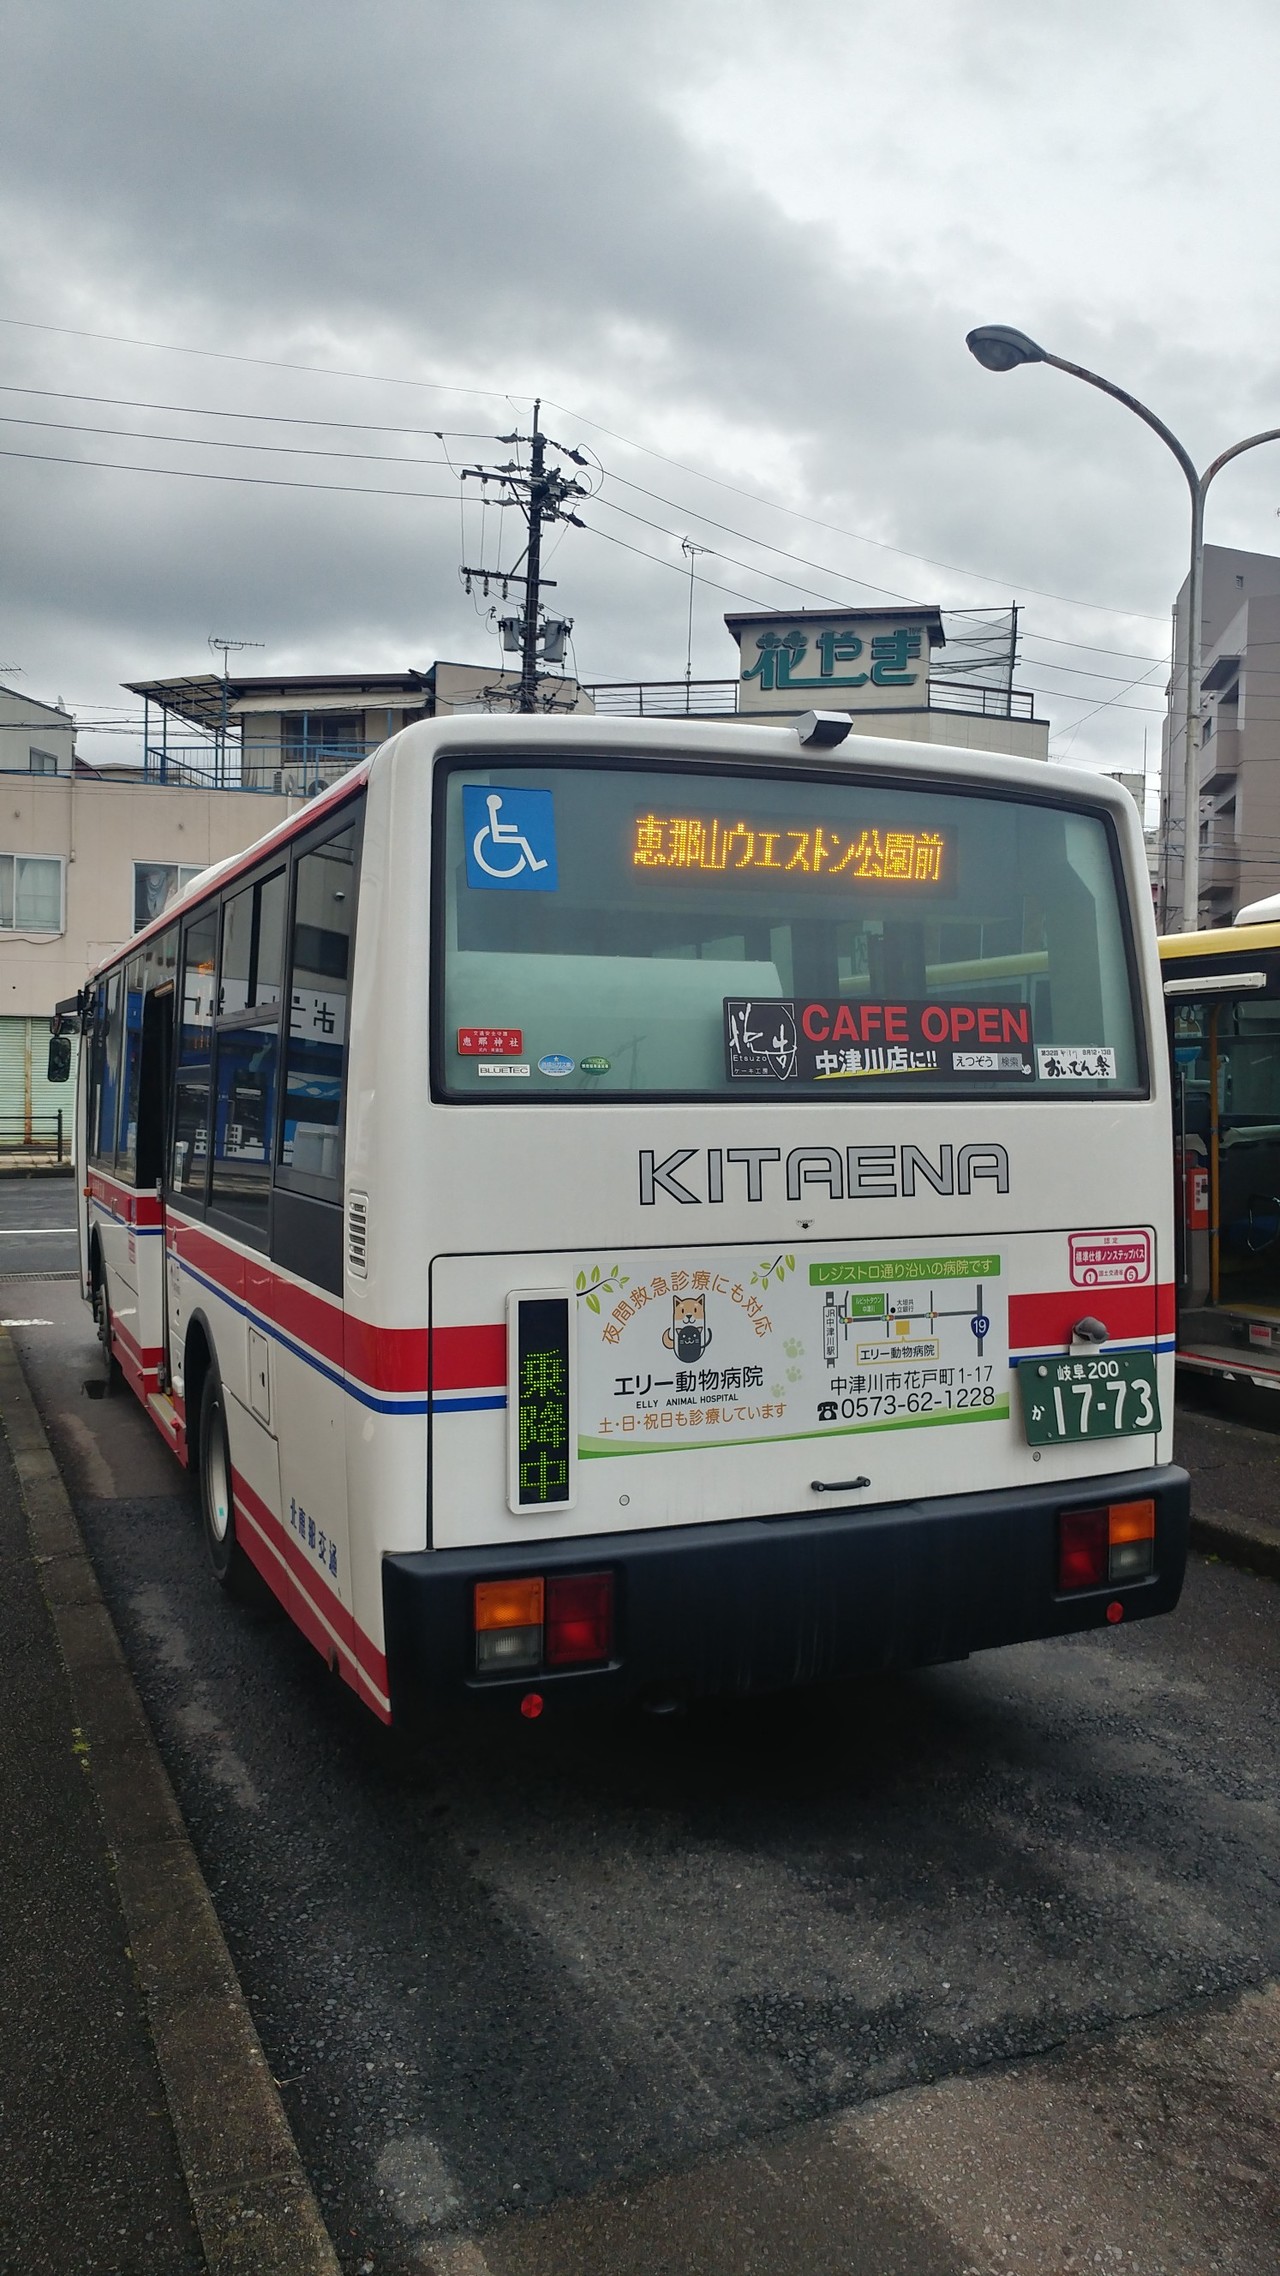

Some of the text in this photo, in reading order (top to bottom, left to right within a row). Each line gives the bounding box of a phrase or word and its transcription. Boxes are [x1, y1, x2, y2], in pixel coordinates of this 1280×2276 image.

[633, 815, 944, 880] 恵那山ウエストン公園前
[802, 1004, 1029, 1043] CAFE OPEN
[733, 1054, 767, 1062] Etsuzo
[815, 1046, 937, 1075] 中津川店に!!
[955, 1056, 1021, 1068] えつぞう 検索
[1044, 1055, 1111, 1077] おいでん祭
[479, 1065, 529, 1074] BLUETEC
[734, 1067, 768, 1075] ケーキ工房
[638, 1143, 1010, 1206] KITAENA
[1075, 1248, 1145, 1263] 標準仕様ノンステップバス
[818, 1260, 993, 1281] レジストロ通り沿いの病院です
[1128, 1271, 1134, 1281] 5
[602, 1270, 773, 1345] 夜間救急診療にも対応
[825, 1309, 836, 1355] JR中津川駅
[973, 1320, 987, 1334] 19
[860, 1344, 936, 1361] エリー動物病院
[614, 1365, 764, 1396] エリー動物病院
[636, 1393, 739, 1409] ELLY ANIMAL HOSPITAL
[841, 1386, 996, 1419] 0573-62-1228
[1052, 1378, 1155, 1436] 17-73
[598, 1402, 788, 1434] 土・日・祝日も診療しています
[1031, 1404, 1046, 1421] か
[520, 1349, 567, 1499] 乗降中
